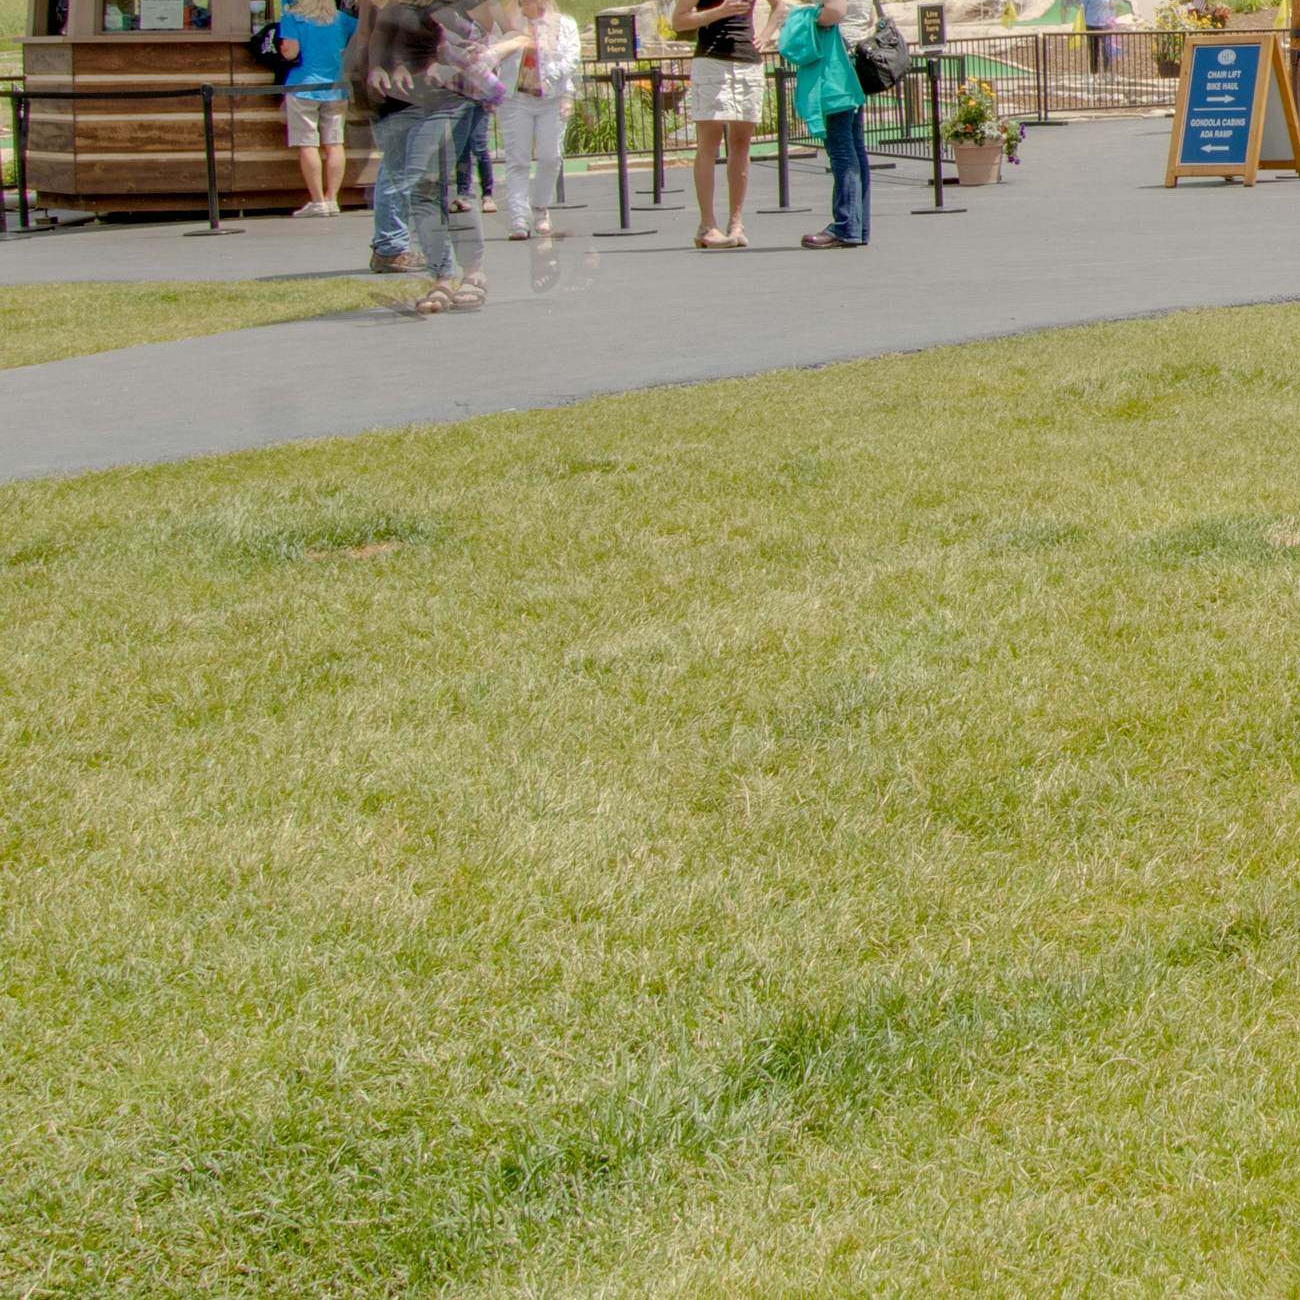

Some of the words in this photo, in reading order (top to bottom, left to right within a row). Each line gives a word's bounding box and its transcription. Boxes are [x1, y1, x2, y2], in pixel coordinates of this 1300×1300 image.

[1207, 71, 1227, 79] CHAIR
[1228, 70, 1242, 79] LIFT
[1206, 83, 1221, 91] BIKE
[1223, 82, 1239, 90] HAUL
[1190, 119, 1221, 127] GONDOLA
[1222, 118, 1246, 127] CABINS
[1200, 130, 1213, 138] ADA
[1214, 130, 1233, 138] RAMP
